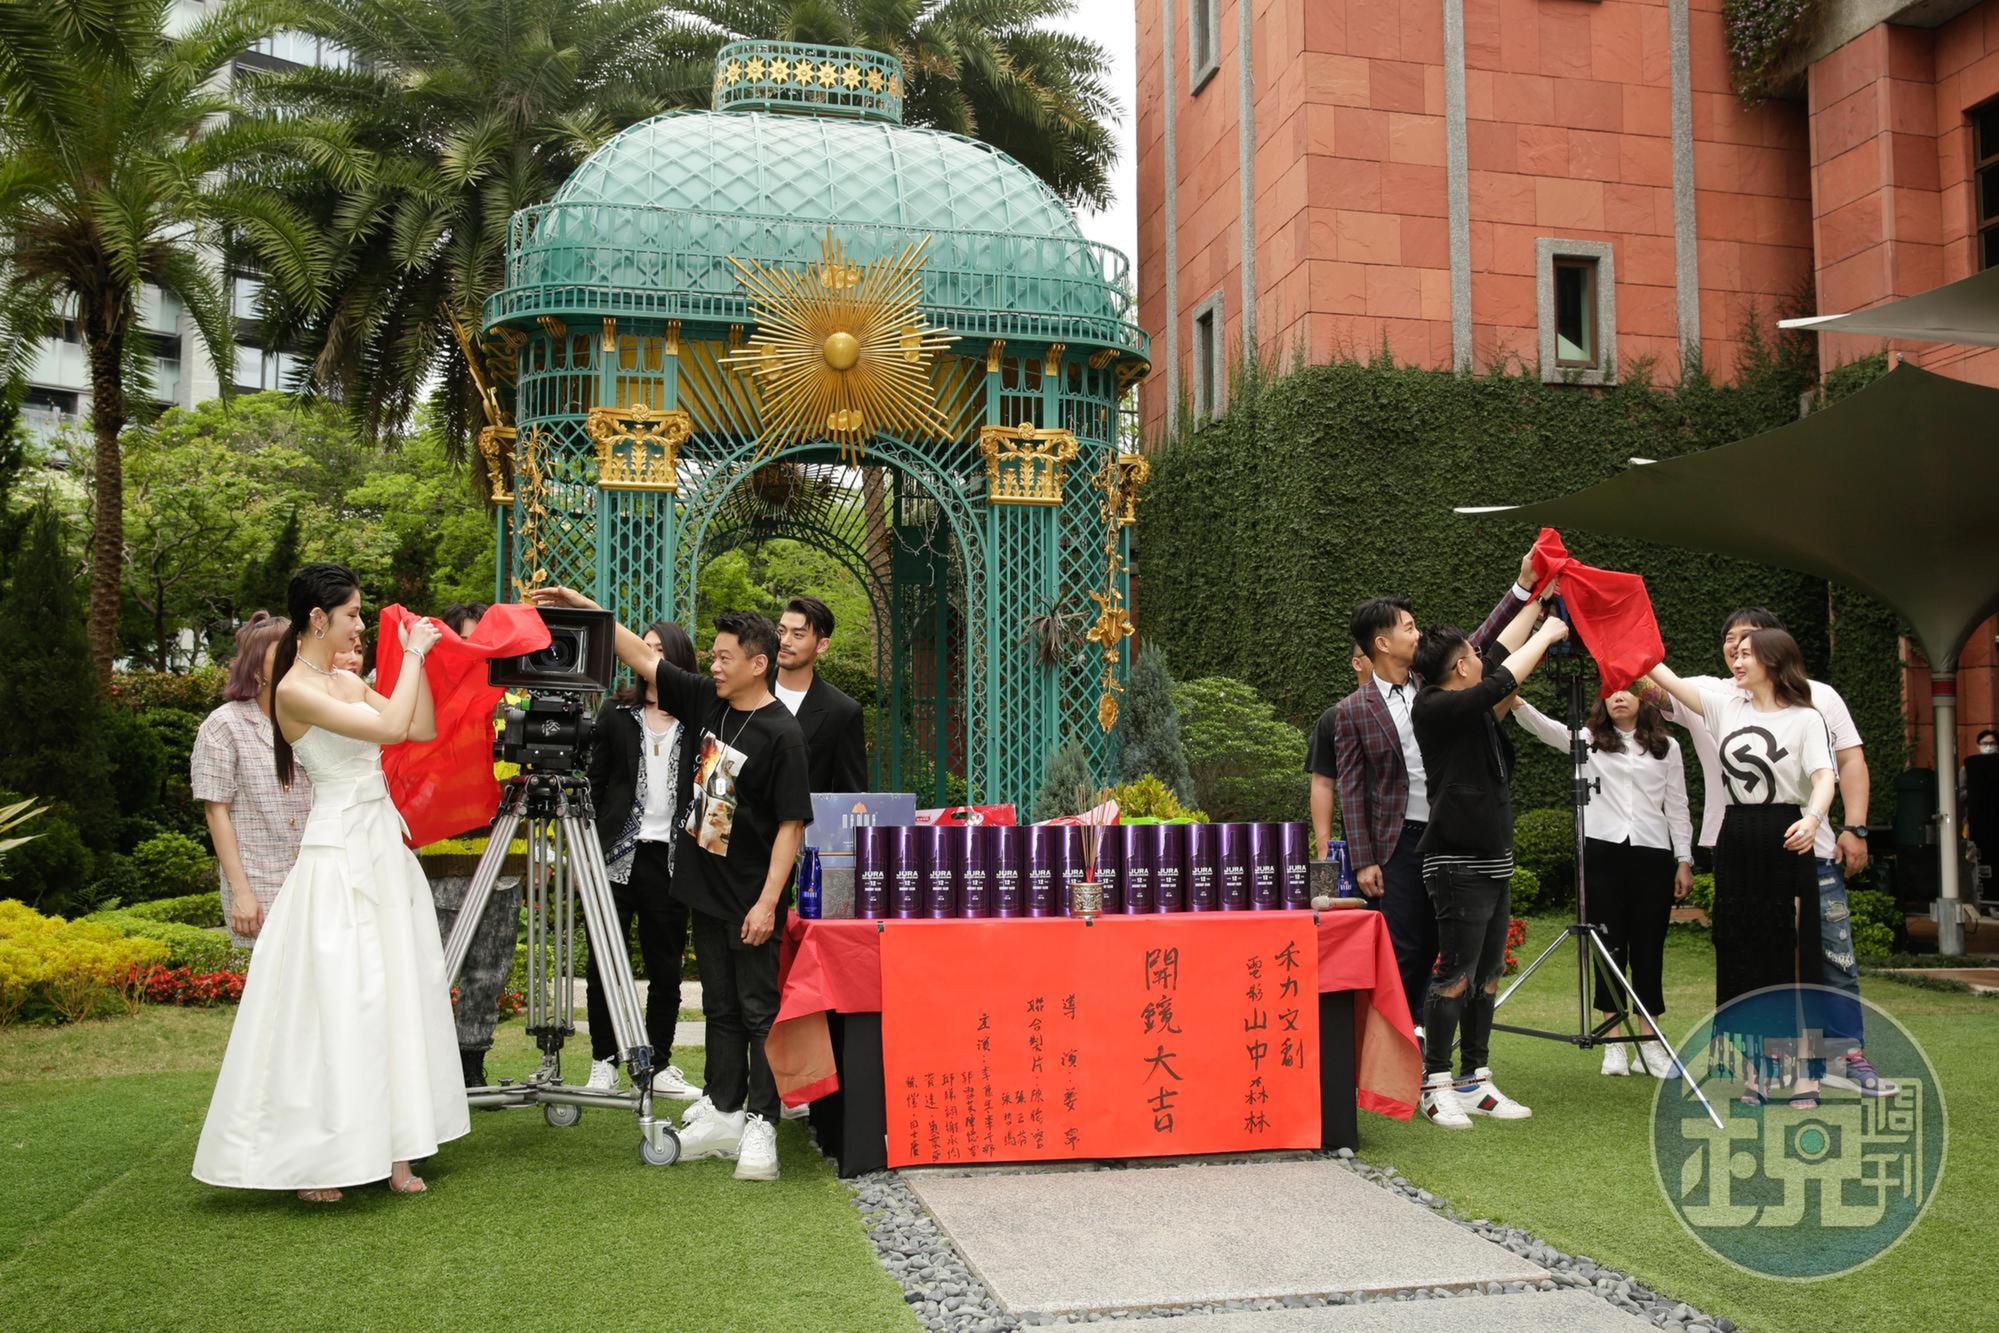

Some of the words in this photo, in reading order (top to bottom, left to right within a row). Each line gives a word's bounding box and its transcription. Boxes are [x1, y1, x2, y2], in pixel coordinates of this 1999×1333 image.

[1140, 947, 1184, 1133] 開鏡大吉
[1274, 940, 1303, 1069] 禾力文創
